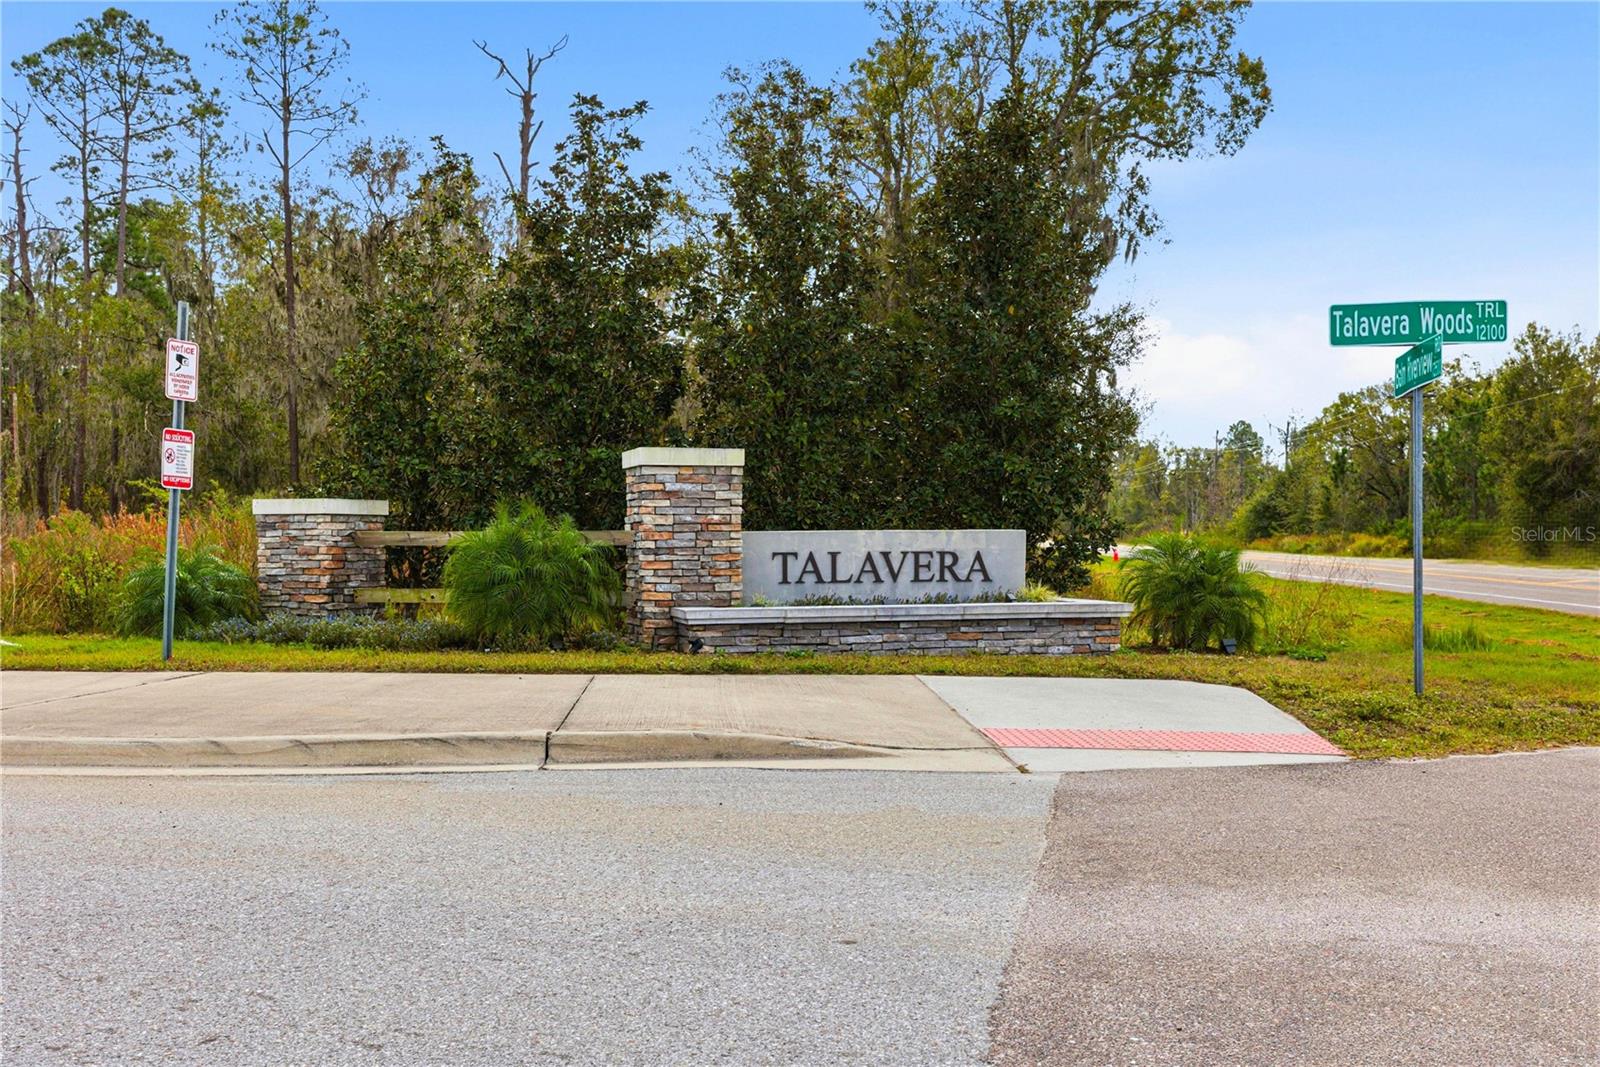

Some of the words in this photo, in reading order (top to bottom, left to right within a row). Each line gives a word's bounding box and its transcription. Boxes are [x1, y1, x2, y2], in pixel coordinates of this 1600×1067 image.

[1475, 302, 1504, 318] TRL
[1333, 310, 1409, 337] Talavera
[1420, 307, 1473, 334] Woods
[1476, 324, 1505, 340] 12100
[171, 345, 195, 355] NOTICE
[771, 550, 993, 585] TALAVERA
